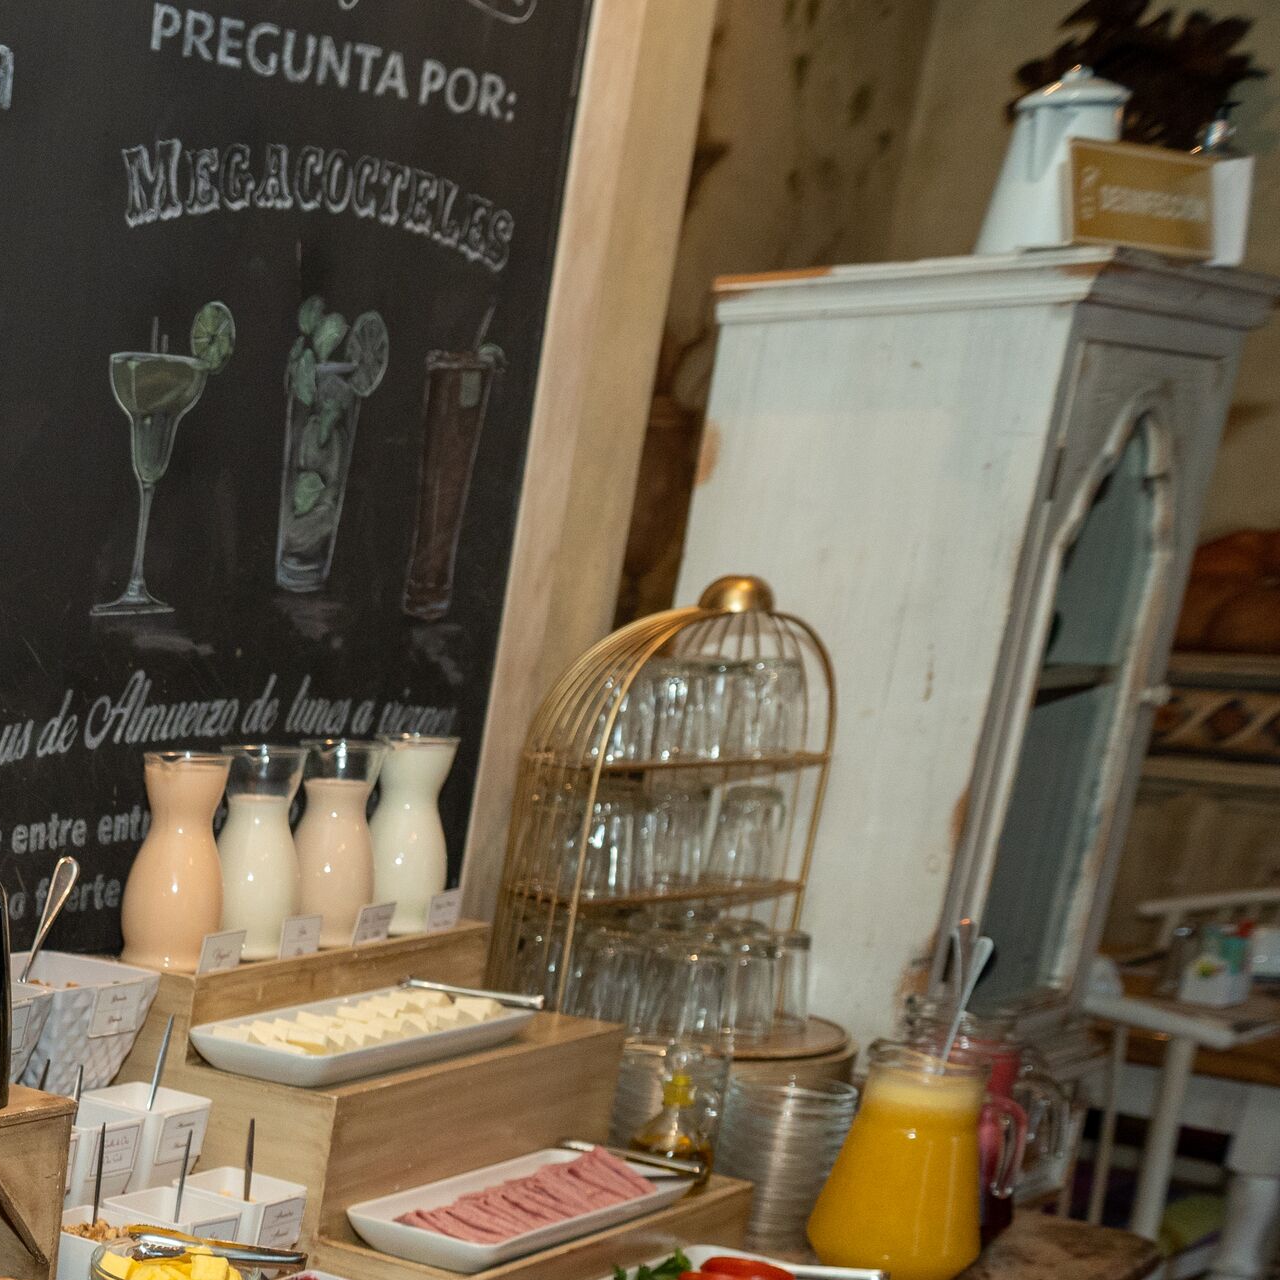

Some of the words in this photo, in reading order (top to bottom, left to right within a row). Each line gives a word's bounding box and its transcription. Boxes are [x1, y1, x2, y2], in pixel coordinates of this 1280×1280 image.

[149, 1, 408, 100] PREGUNTA
[418, 58, 518, 122] POR:
[121, 137, 516, 273] MEGACOCTELES
[37, 688, 78, 758] de
[84, 669, 239, 751] Almuerzo
[241, 672, 280, 735] de
[284, 673, 352, 736] lunes
[351, 700, 375, 735] a
[11, 812, 88, 855] entre
[35, 873, 122, 917] ferte
